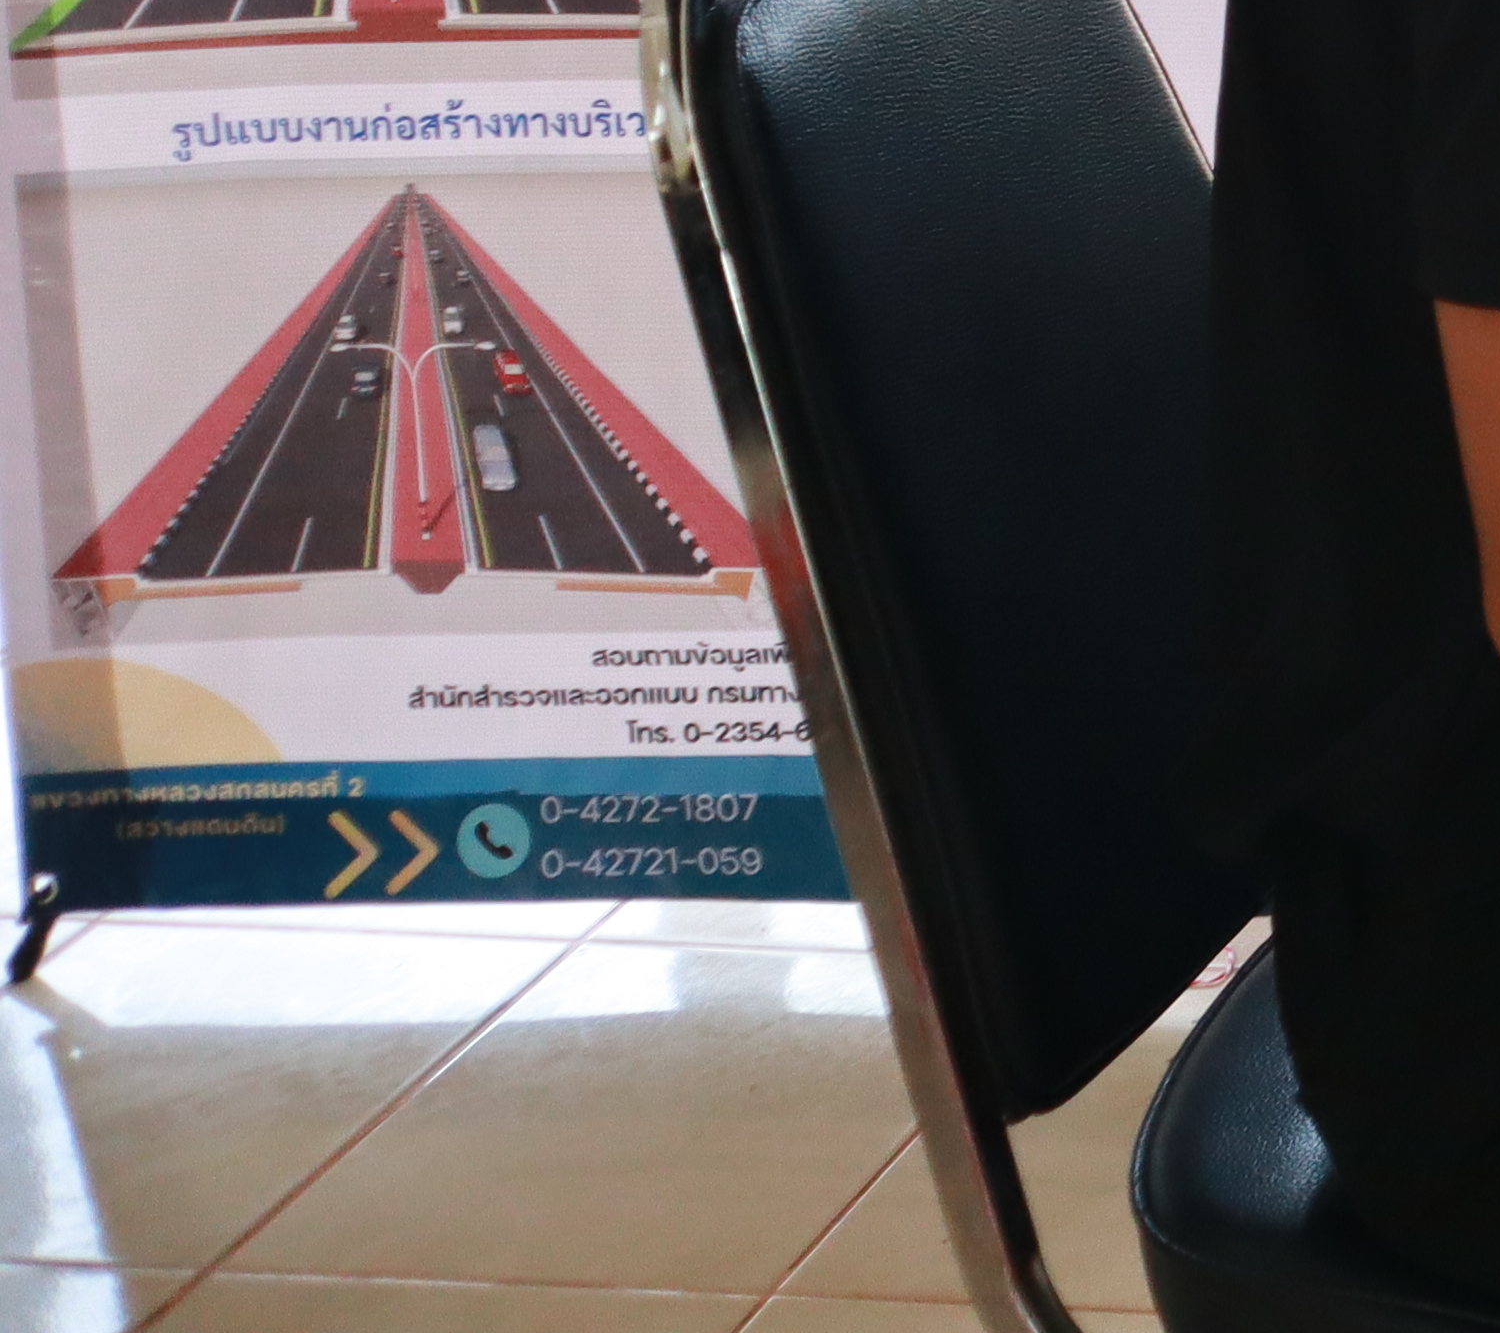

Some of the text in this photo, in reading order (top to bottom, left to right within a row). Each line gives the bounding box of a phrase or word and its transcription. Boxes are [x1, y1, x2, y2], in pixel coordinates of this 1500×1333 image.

[171, 99, 644, 162] รูปแบบงานก่อสร้างทางบริเว
[593, 641, 790, 672] สอบถามข้อมูลเพิ
[409, 685, 801, 709] สำนักสำรวจและออกแบบ กรมทาง
[628, 720, 811, 745] โทร. 0-2354-6
[348, 777, 365, 798] 2
[541, 794, 759, 824] 0-4272-1807
[542, 848, 762, 879] 0-42721-059
